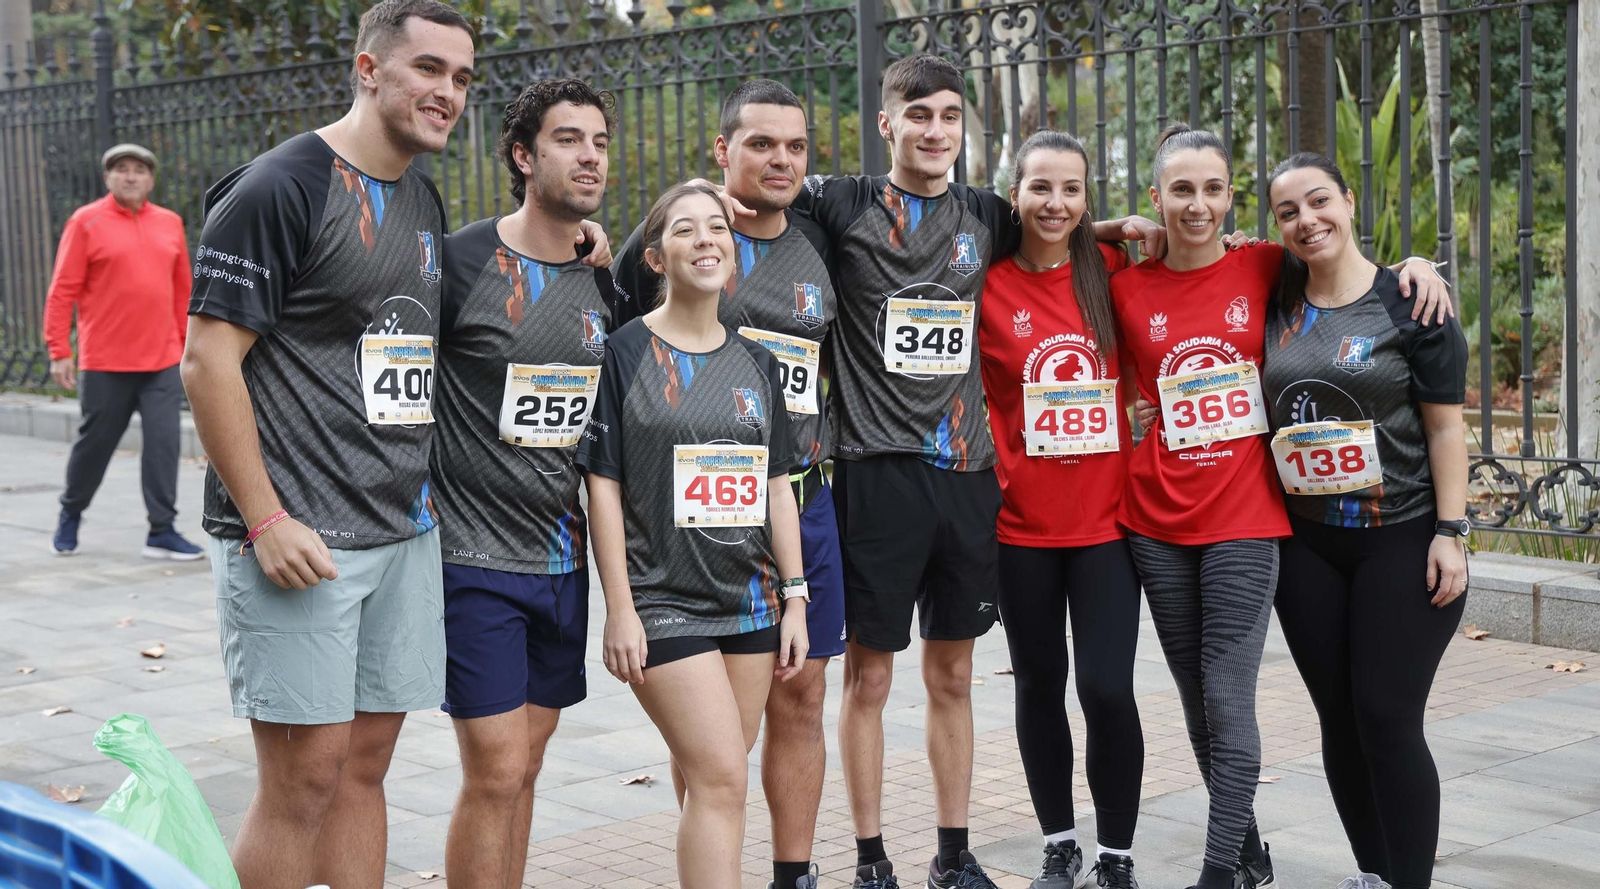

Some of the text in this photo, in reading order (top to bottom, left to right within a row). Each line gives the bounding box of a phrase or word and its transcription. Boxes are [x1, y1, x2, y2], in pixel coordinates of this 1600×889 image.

[205, 246, 271, 279] @mpgtraining
[201, 264, 255, 289] @jsphysios
[905, 307, 938, 319] CARRERA
[939, 308, 963, 320] NAVIDAD
[1014, 322, 1032, 330] UCA
[1150, 326, 1167, 334] UCA
[894, 325, 964, 355] 348
[1172, 336, 1222, 354] SOLIDARIA
[1222, 342, 1237, 354] DE
[383, 346, 415, 358] CARRERA
[785, 343, 808, 358] NAVIDAD
[1023, 347, 1042, 384] ARRERA
[1038, 333, 1086, 350] SOLIDARIA
[373, 367, 432, 401] 400
[530, 374, 560, 387] CARRERA
[562, 375, 588, 388] NAVIDAD
[779, 361, 808, 395] 09
[1177, 378, 1208, 394] CARRERA
[1209, 372, 1240, 387] NAVIDAD
[1042, 390, 1074, 402] CARRERA
[1075, 389, 1102, 400] NAVIDAD
[514, 395, 588, 427] 252
[1171, 389, 1251, 429] 366
[1034, 406, 1107, 436] 489
[1287, 431, 1320, 444] CARRERA
[1320, 428, 1354, 439] NAVIDAD
[695, 455, 755, 468] CARRERA NAVIDAD
[1178, 450, 1233, 460] CUPRA
[1284, 444, 1366, 478] 138
[684, 475, 758, 506] 463
[313, 528, 338, 537] LANE
[453, 549, 474, 558] LANE
